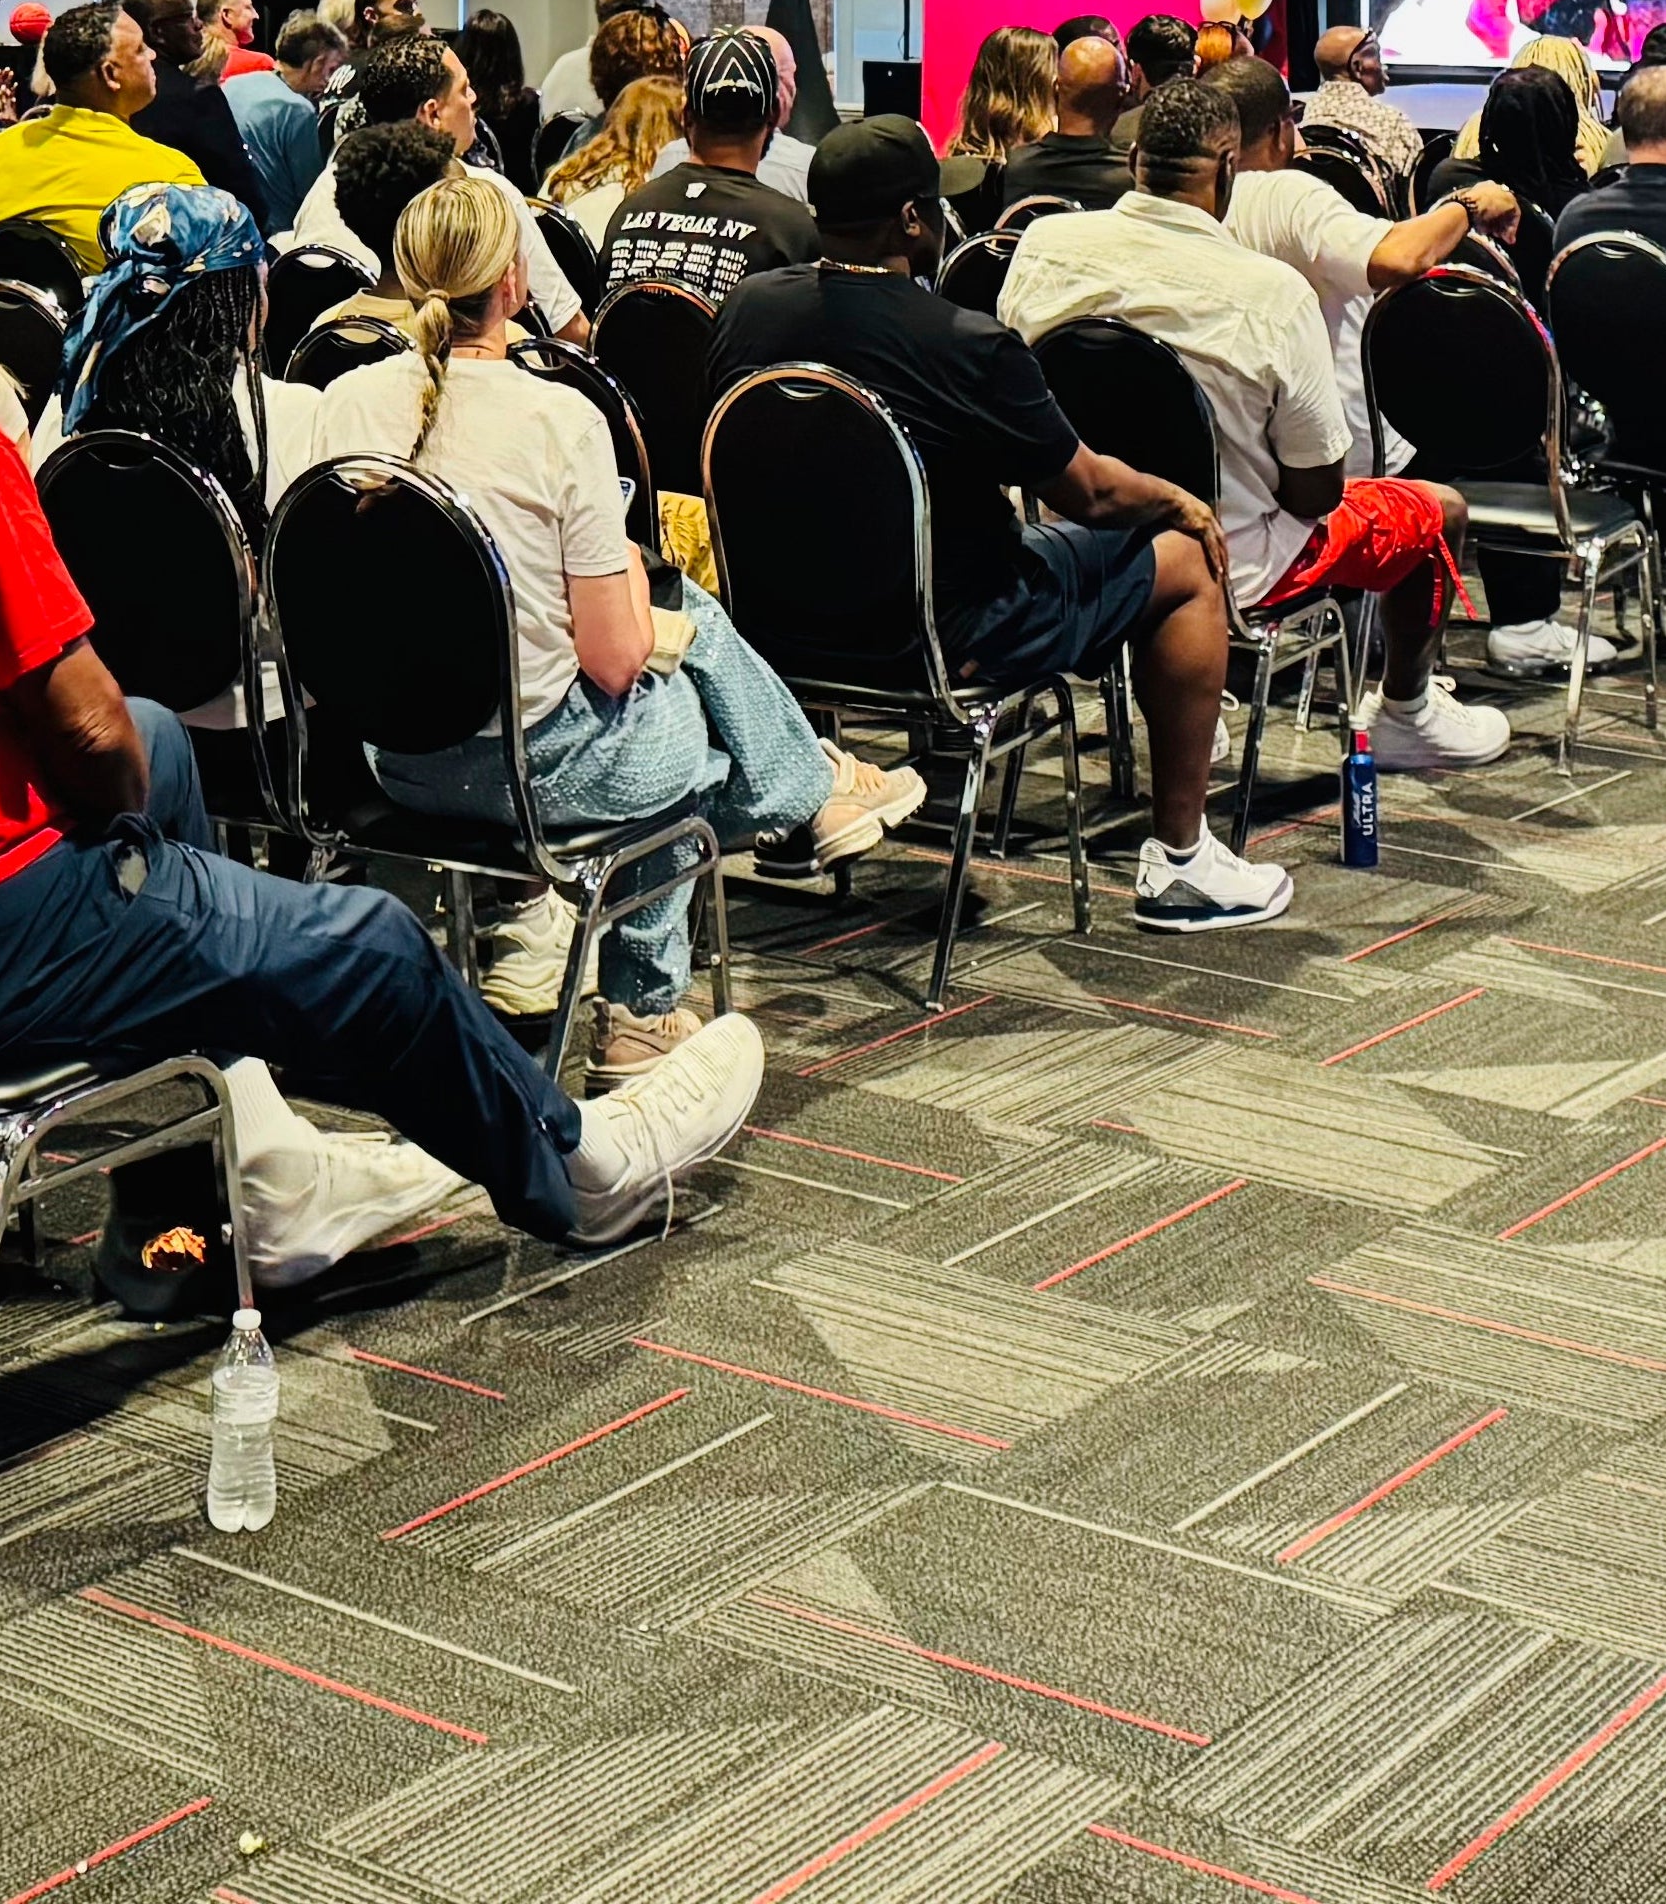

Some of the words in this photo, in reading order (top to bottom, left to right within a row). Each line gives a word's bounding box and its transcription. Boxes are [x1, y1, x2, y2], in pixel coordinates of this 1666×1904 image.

[621, 211, 656, 231] LAS
[657, 211, 718, 237] VEGAS,
[719, 219, 757, 241] NV
[1361, 782, 1374, 836] ULTRA
